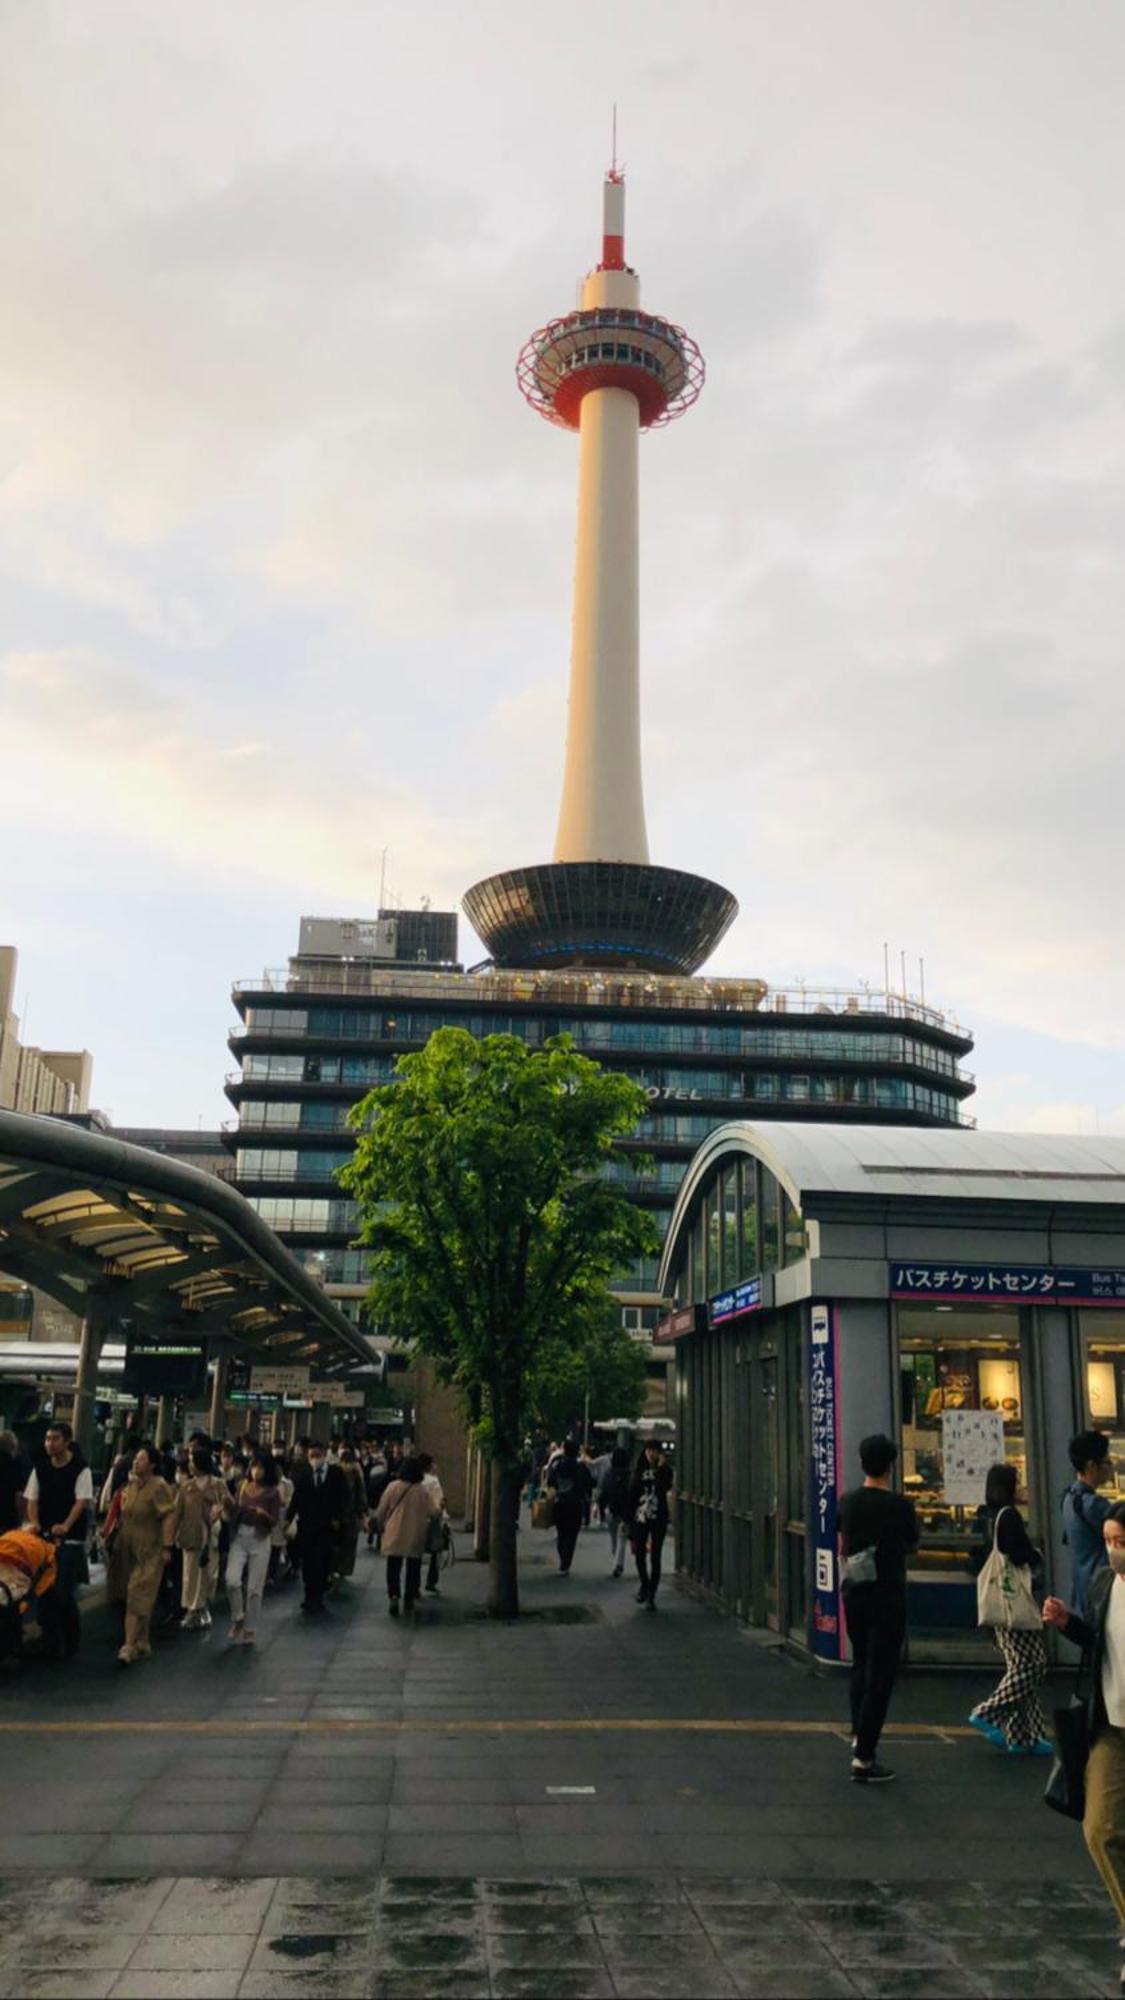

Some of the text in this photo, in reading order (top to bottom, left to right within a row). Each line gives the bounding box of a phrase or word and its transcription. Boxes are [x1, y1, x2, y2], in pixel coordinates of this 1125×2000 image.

[644, 1086, 704, 1101] OTEL
[896, 1269, 1076, 1291] バスチケットセンター
[813, 1350, 828, 1534] バスチケットセンター
